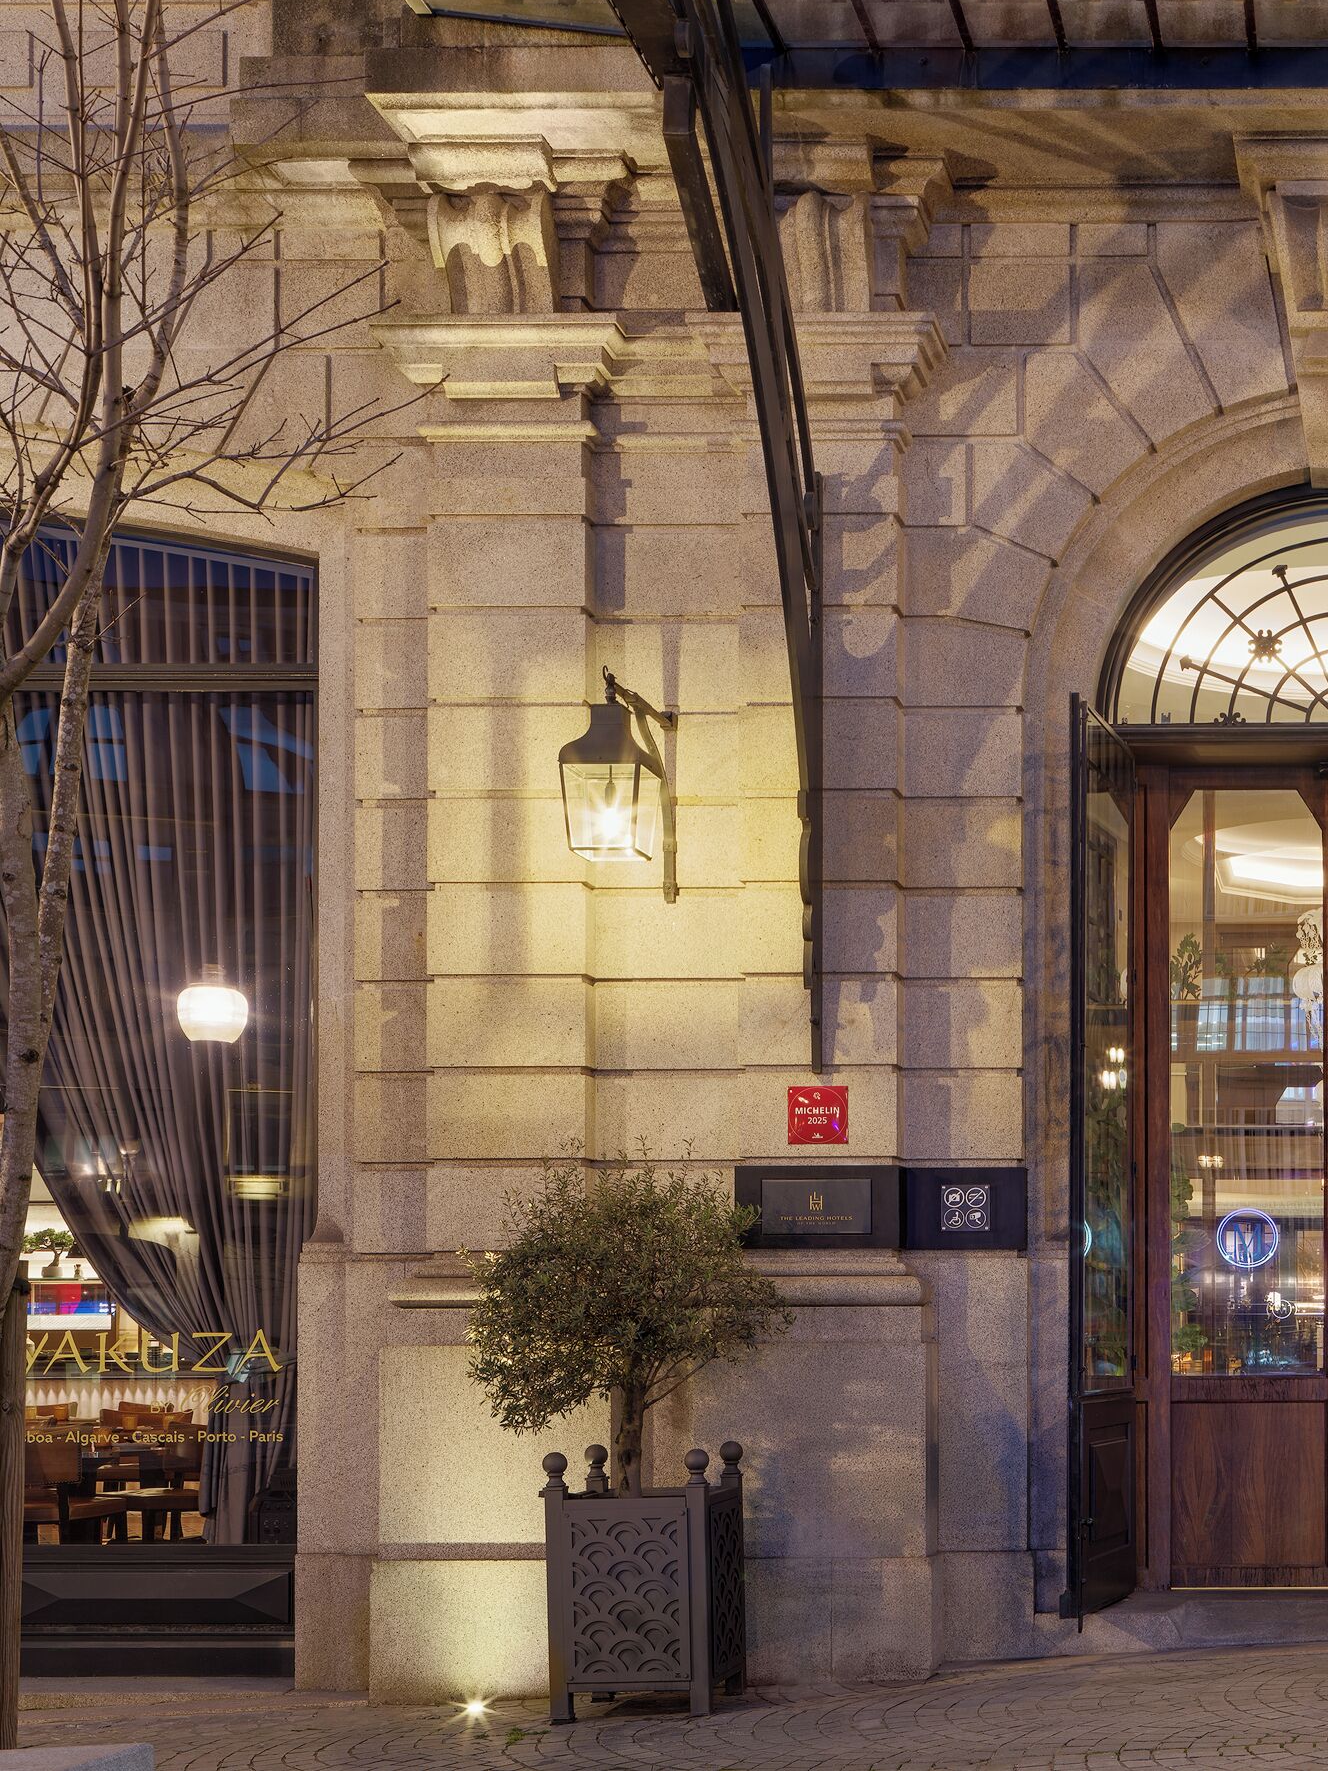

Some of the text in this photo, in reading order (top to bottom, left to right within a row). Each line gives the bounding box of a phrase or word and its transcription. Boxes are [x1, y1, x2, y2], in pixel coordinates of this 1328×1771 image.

[795, 1107, 840, 1115] MICHELIN
[807, 1116, 828, 1125] 2025
[151, 1385, 280, 1415] BY Olivier
[65, 1430, 120, 1446] Algarve
[132, 1430, 185, 1443] Cascais
[197, 1431, 237, 1443] Porto
[249, 1431, 284, 1443] Paris
